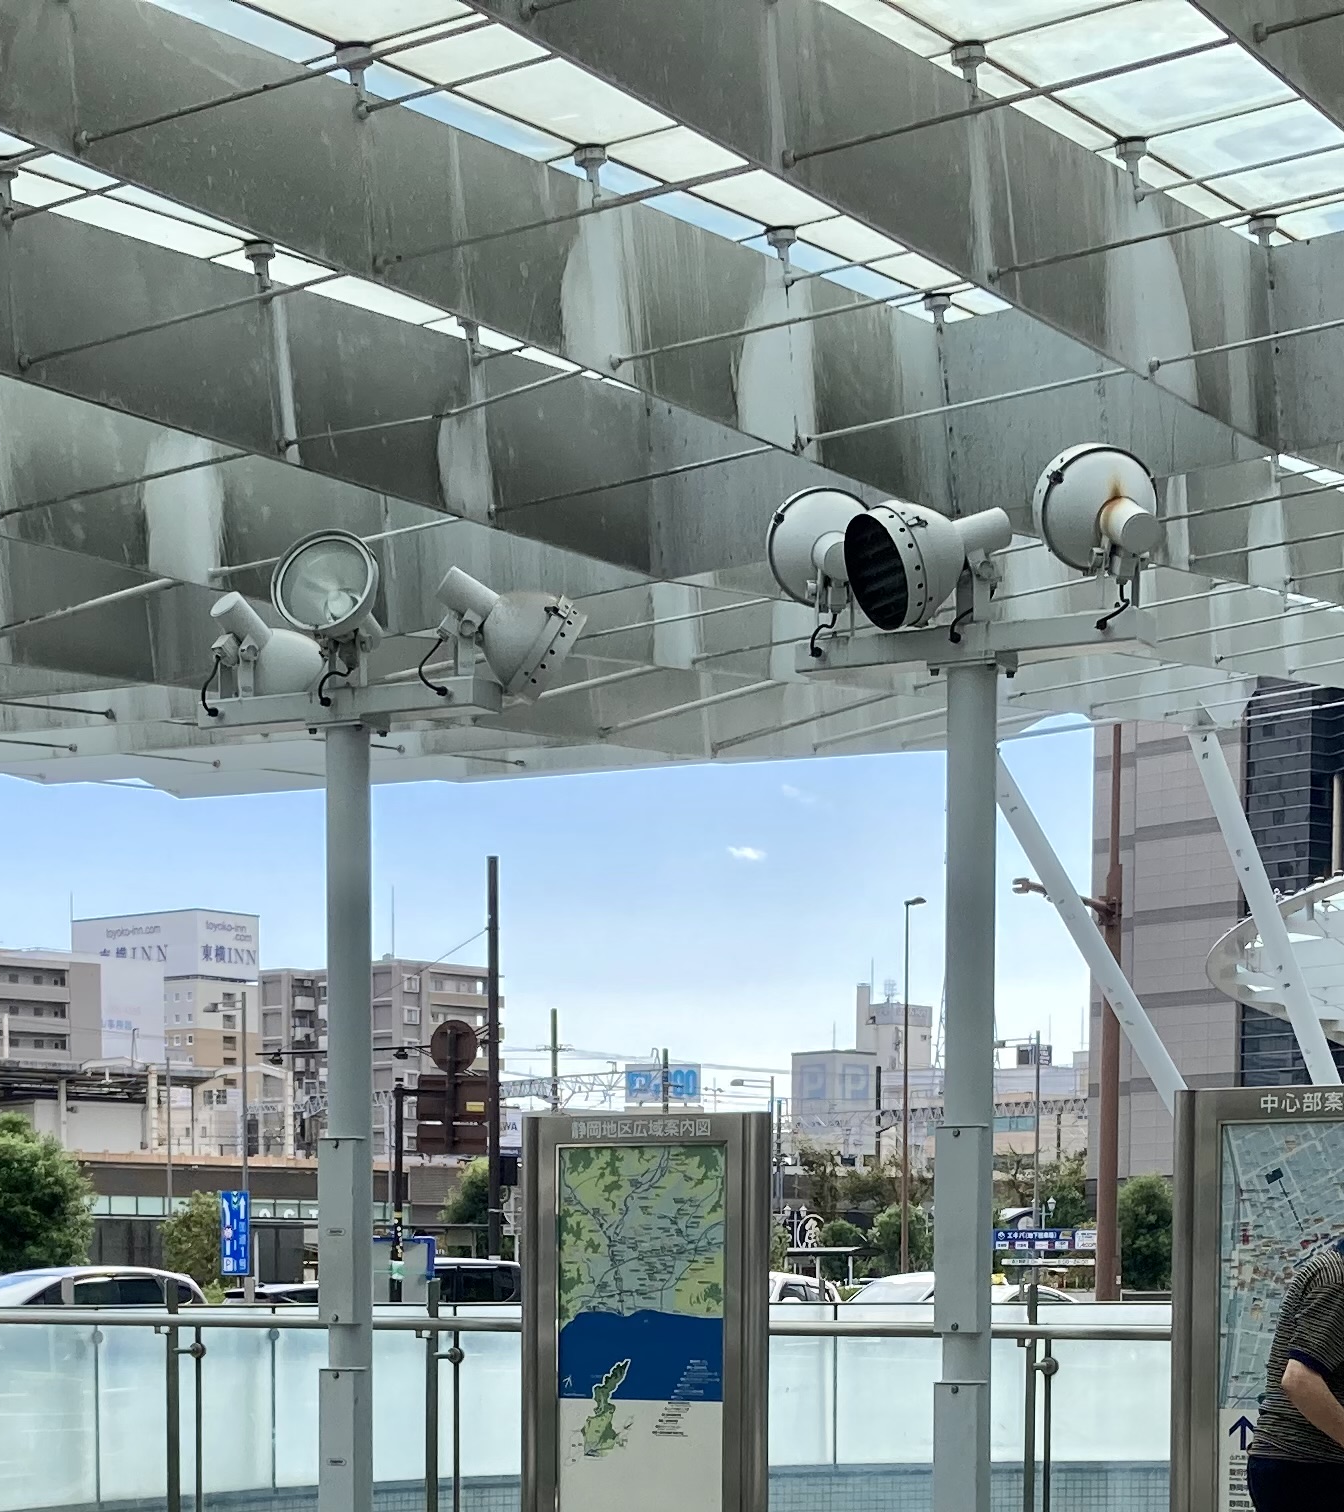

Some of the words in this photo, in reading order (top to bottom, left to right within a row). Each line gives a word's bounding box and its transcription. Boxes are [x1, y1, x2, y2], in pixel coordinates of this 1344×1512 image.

[201, 944, 257, 966] 東横INN
[571, 1118, 711, 1139] 静岡地区広域案内図
